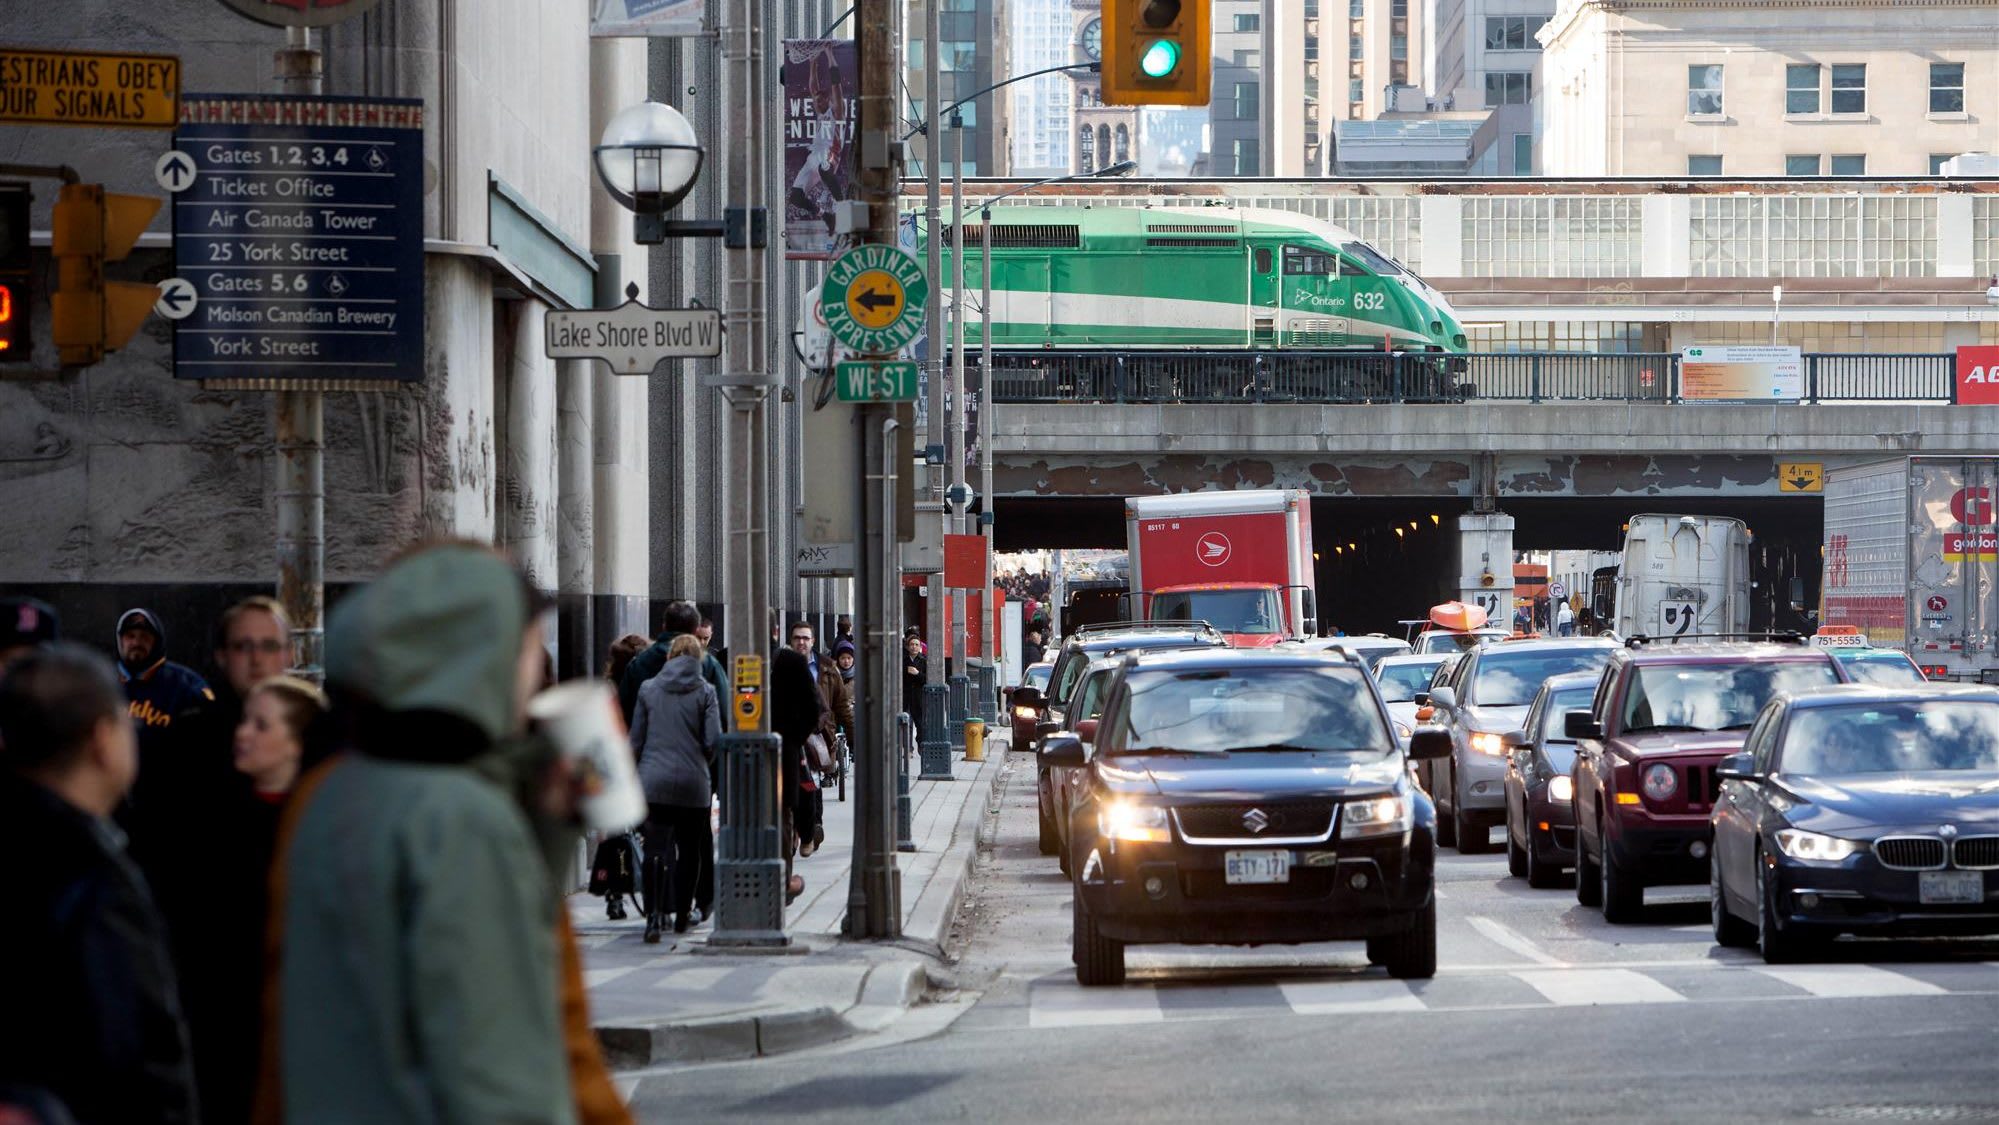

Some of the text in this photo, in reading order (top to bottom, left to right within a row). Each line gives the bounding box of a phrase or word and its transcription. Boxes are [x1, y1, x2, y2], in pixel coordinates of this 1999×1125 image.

[118, 61, 172, 90] OBEY
[54, 90, 145, 119] SIGNALS
[181, 104, 422, 124] AIR CANADA CENTRE
[790, 98, 814, 117] WE
[207, 145, 261, 164] Gates
[208, 177, 335, 197] Ticket Office
[208, 209, 377, 229] Air Canada Tower
[208, 243, 349, 262] 25 York Street
[830, 247, 922, 287] GARDINER
[208, 273, 262, 291] Gates
[1311, 297, 1345, 306] Ontario
[1354, 292, 1384, 310] 632
[208, 306, 397, 329] Molson Canadian Brewery
[824, 302, 925, 352] EXPRESSWAY
[551, 321, 713, 348] Lake Shore Blvd W
[209, 337, 320, 355] York Street
[848, 367, 908, 398] WEST
[1950, 487, 1992, 526] G
[1953, 536, 1999, 552] gordon
[1828, 627, 1848, 635] BECK
[1818, 636, 1861, 646] 751-5555
[1266, 858, 1286, 876] 171
